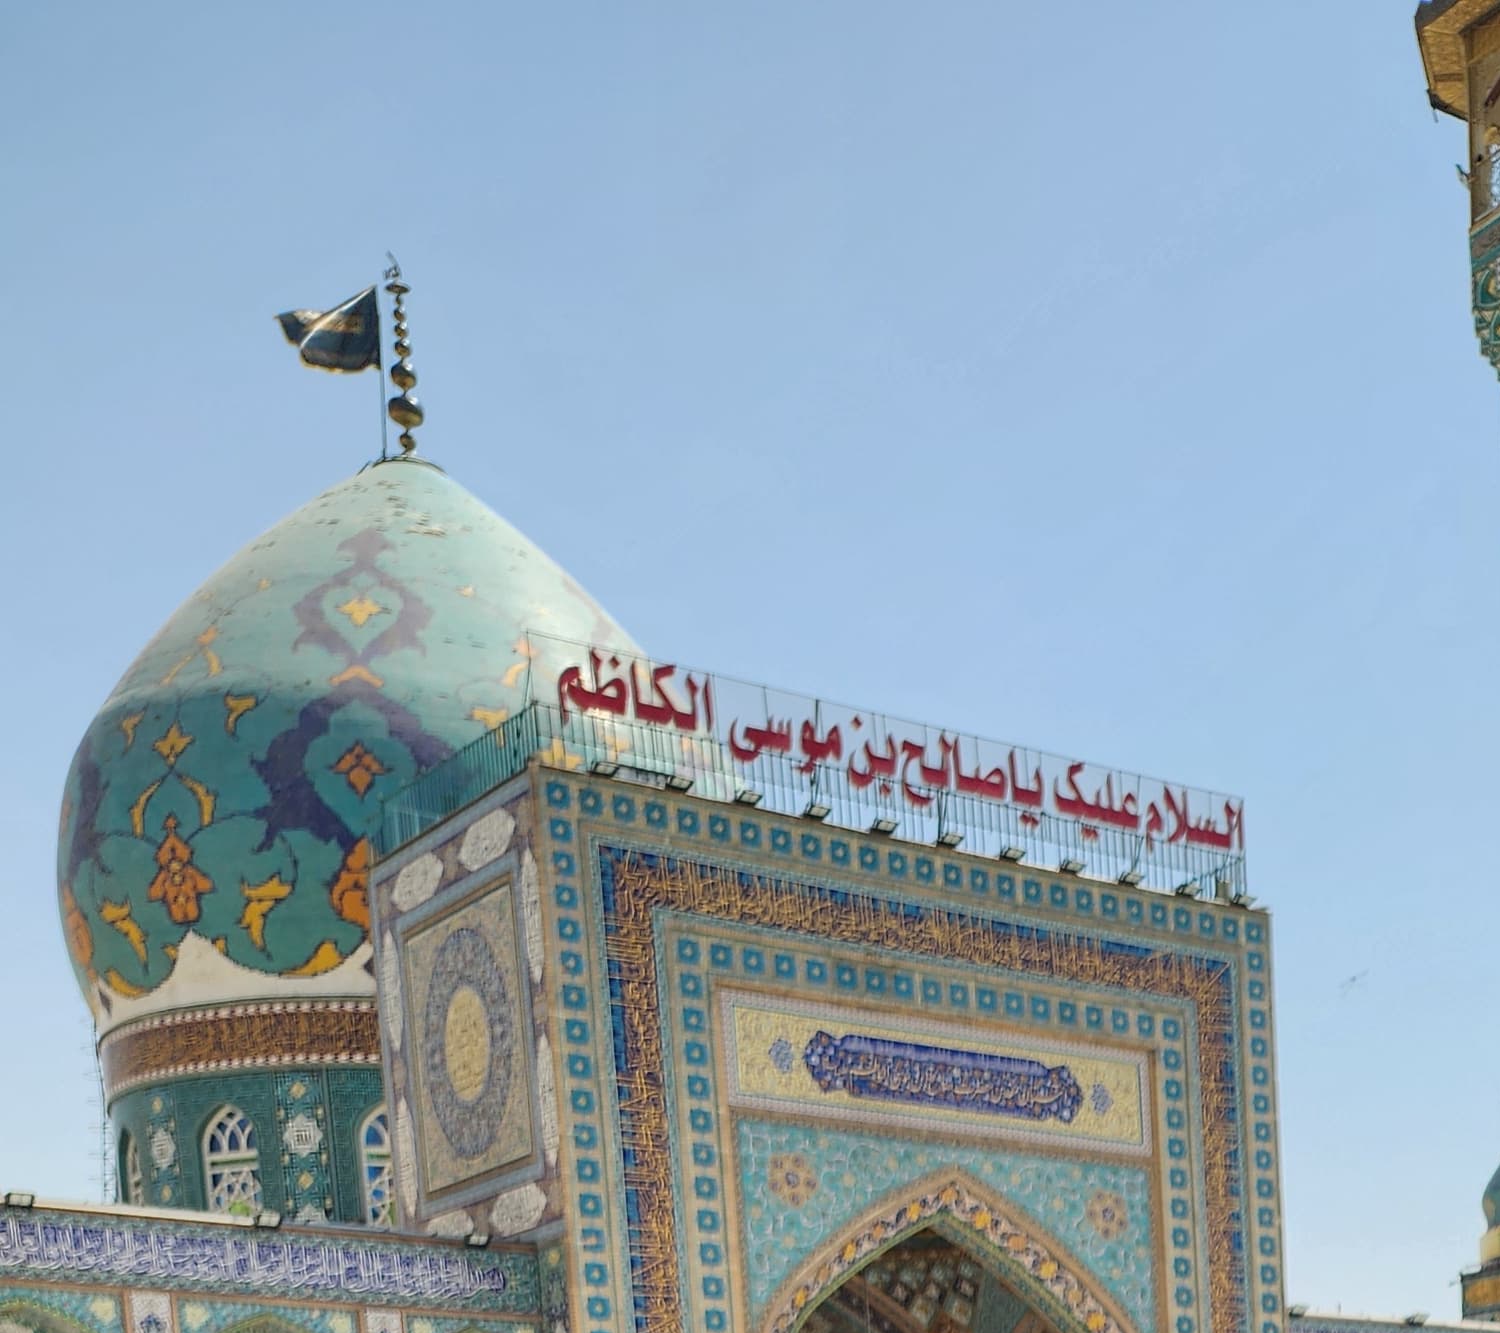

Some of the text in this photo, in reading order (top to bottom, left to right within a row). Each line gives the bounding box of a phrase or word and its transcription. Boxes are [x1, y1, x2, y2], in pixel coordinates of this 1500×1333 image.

[558, 646, 714, 733] الکاظم
[729, 715, 842, 774] موسی
[848, 713, 898, 798] بن
[901, 731, 1005, 808] صالح
[1054, 762, 1140, 840] علیک
[1146, 783, 1244, 853] السلام
